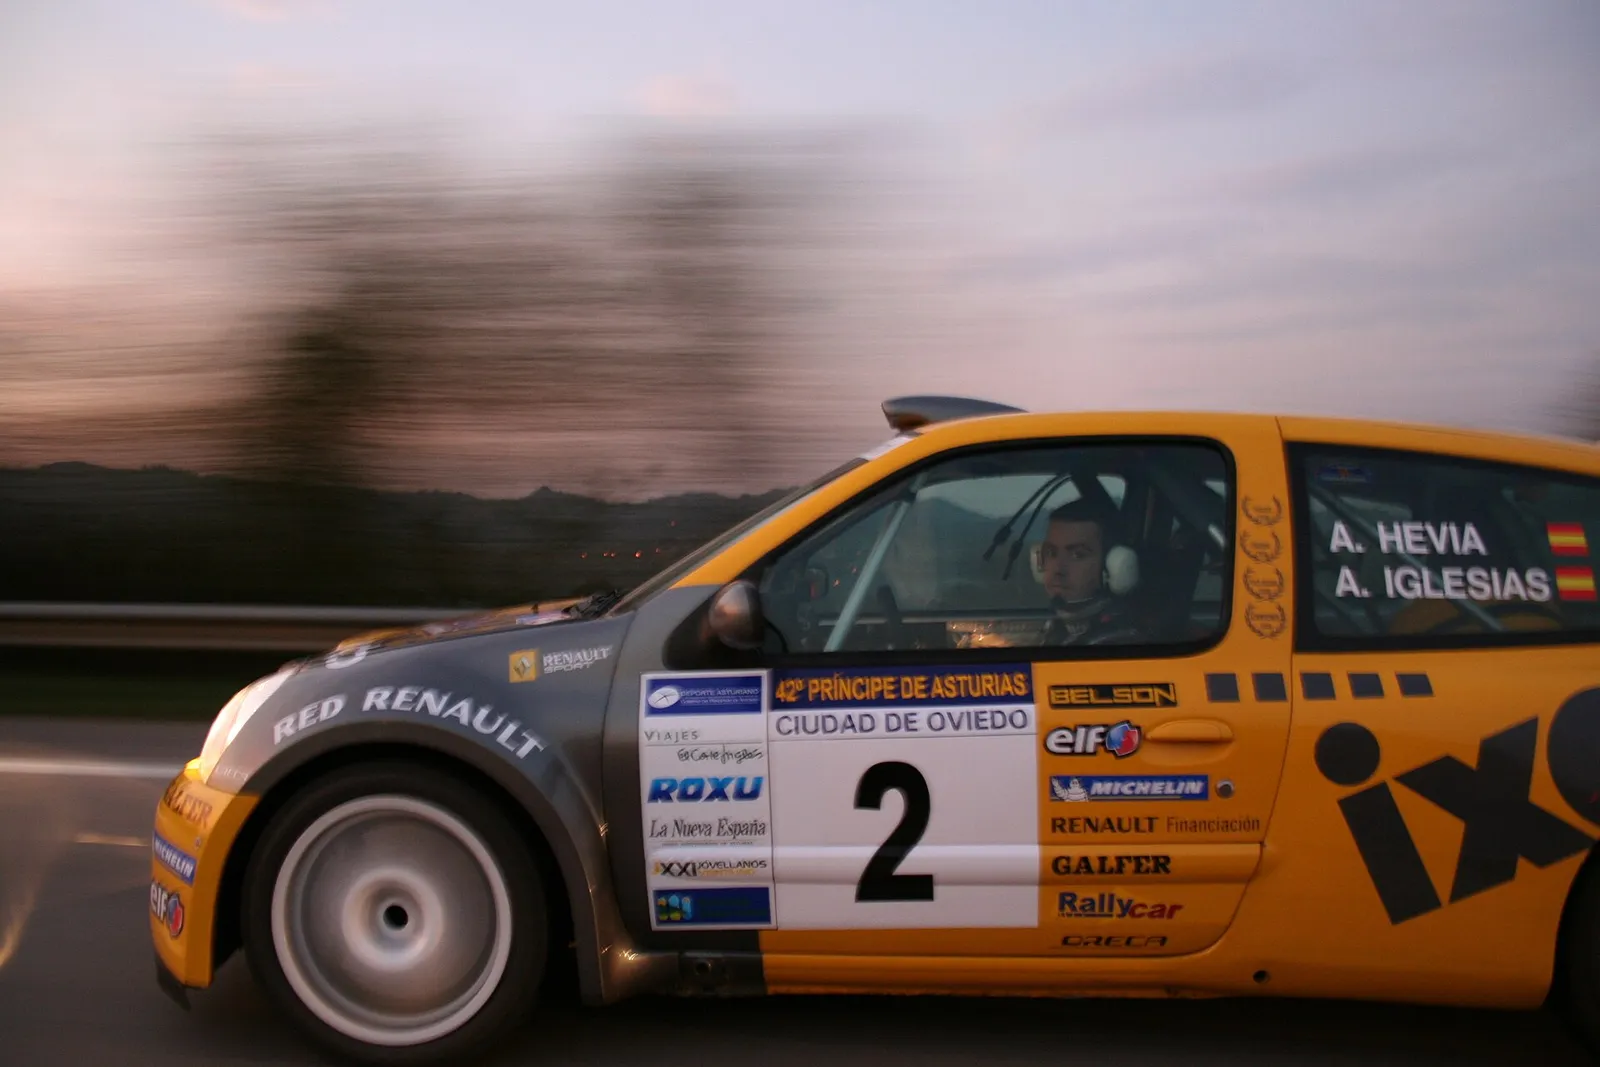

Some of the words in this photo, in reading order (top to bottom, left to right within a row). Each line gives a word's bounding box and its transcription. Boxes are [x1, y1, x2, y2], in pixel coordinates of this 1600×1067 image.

[1330, 520, 1365, 553] A.
[1377, 520, 1487, 555] HEVIA
[1335, 565, 1372, 597] A.
[1384, 566, 1550, 601] IGLESIAS
[543, 645, 613, 666] RENAULT
[544, 660, 594, 674] SPORT
[808, 672, 895, 701] PRÍNCIPE
[901, 675, 928, 699] DE
[931, 672, 1028, 698] ASTURIAS
[1050, 685, 1177, 707] BELSON
[272, 693, 347, 745] RED
[361, 685, 548, 760] RENAULT
[776, 712, 875, 736] CIUDAD
[885, 712, 918, 733] DE
[927, 709, 1028, 732] OVIEDO
[644, 730, 699, 743] VIAJES
[1046, 724, 1108, 754] elf
[647, 777, 764, 803] ROXU
[1090, 780, 1205, 796] MICHELIN
[649, 819, 668, 838] La
[671, 819, 712, 837] Nueva
[716, 817, 766, 839] España
[853, 761, 934, 903] 2
[1051, 816, 1159, 834] RENAULT
[1166, 816, 1260, 834] Financiación
[154, 839, 194, 879] MICHELIN
[697, 860, 767, 870] JOVELLANOS
[1052, 855, 1171, 875] GALFER
[150, 882, 168, 921] elf
